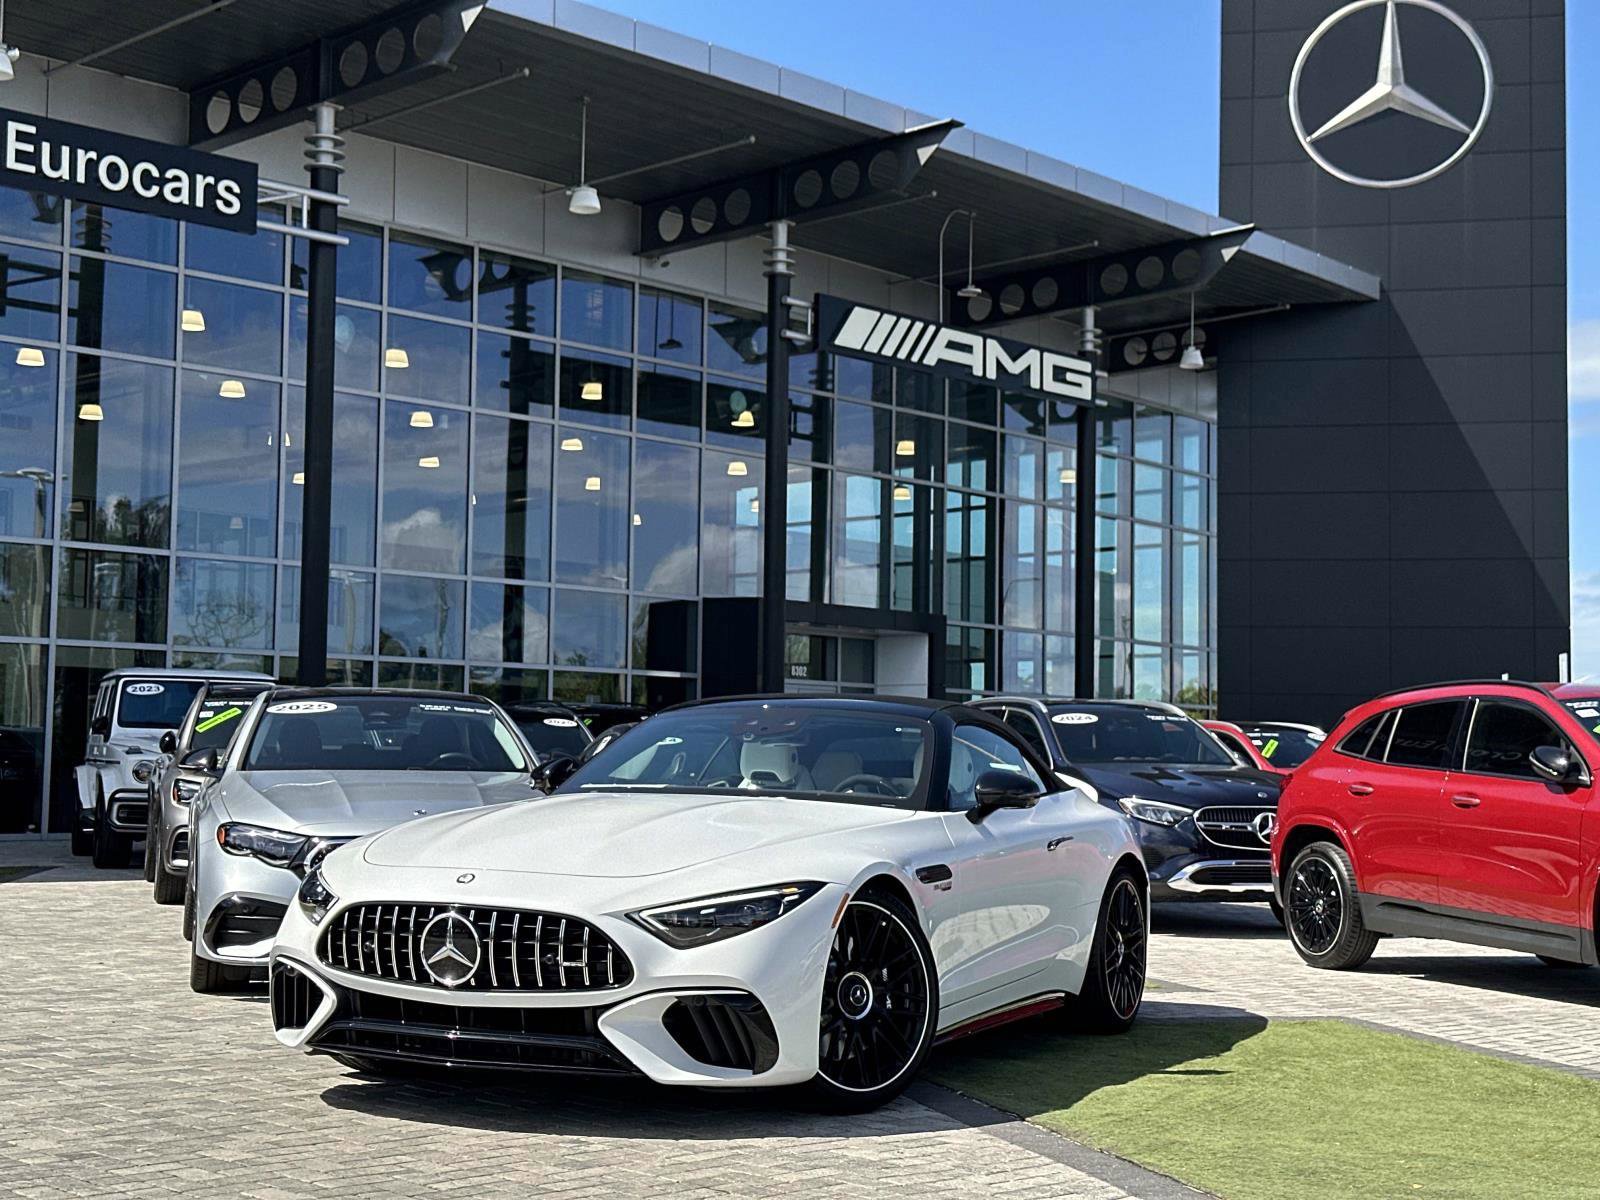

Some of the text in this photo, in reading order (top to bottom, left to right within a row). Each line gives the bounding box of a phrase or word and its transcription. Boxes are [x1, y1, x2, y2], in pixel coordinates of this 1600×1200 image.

[6, 120, 242, 216] Eurocars
[130, 685, 161, 693] 2023
[275, 703, 329, 712] 2025
